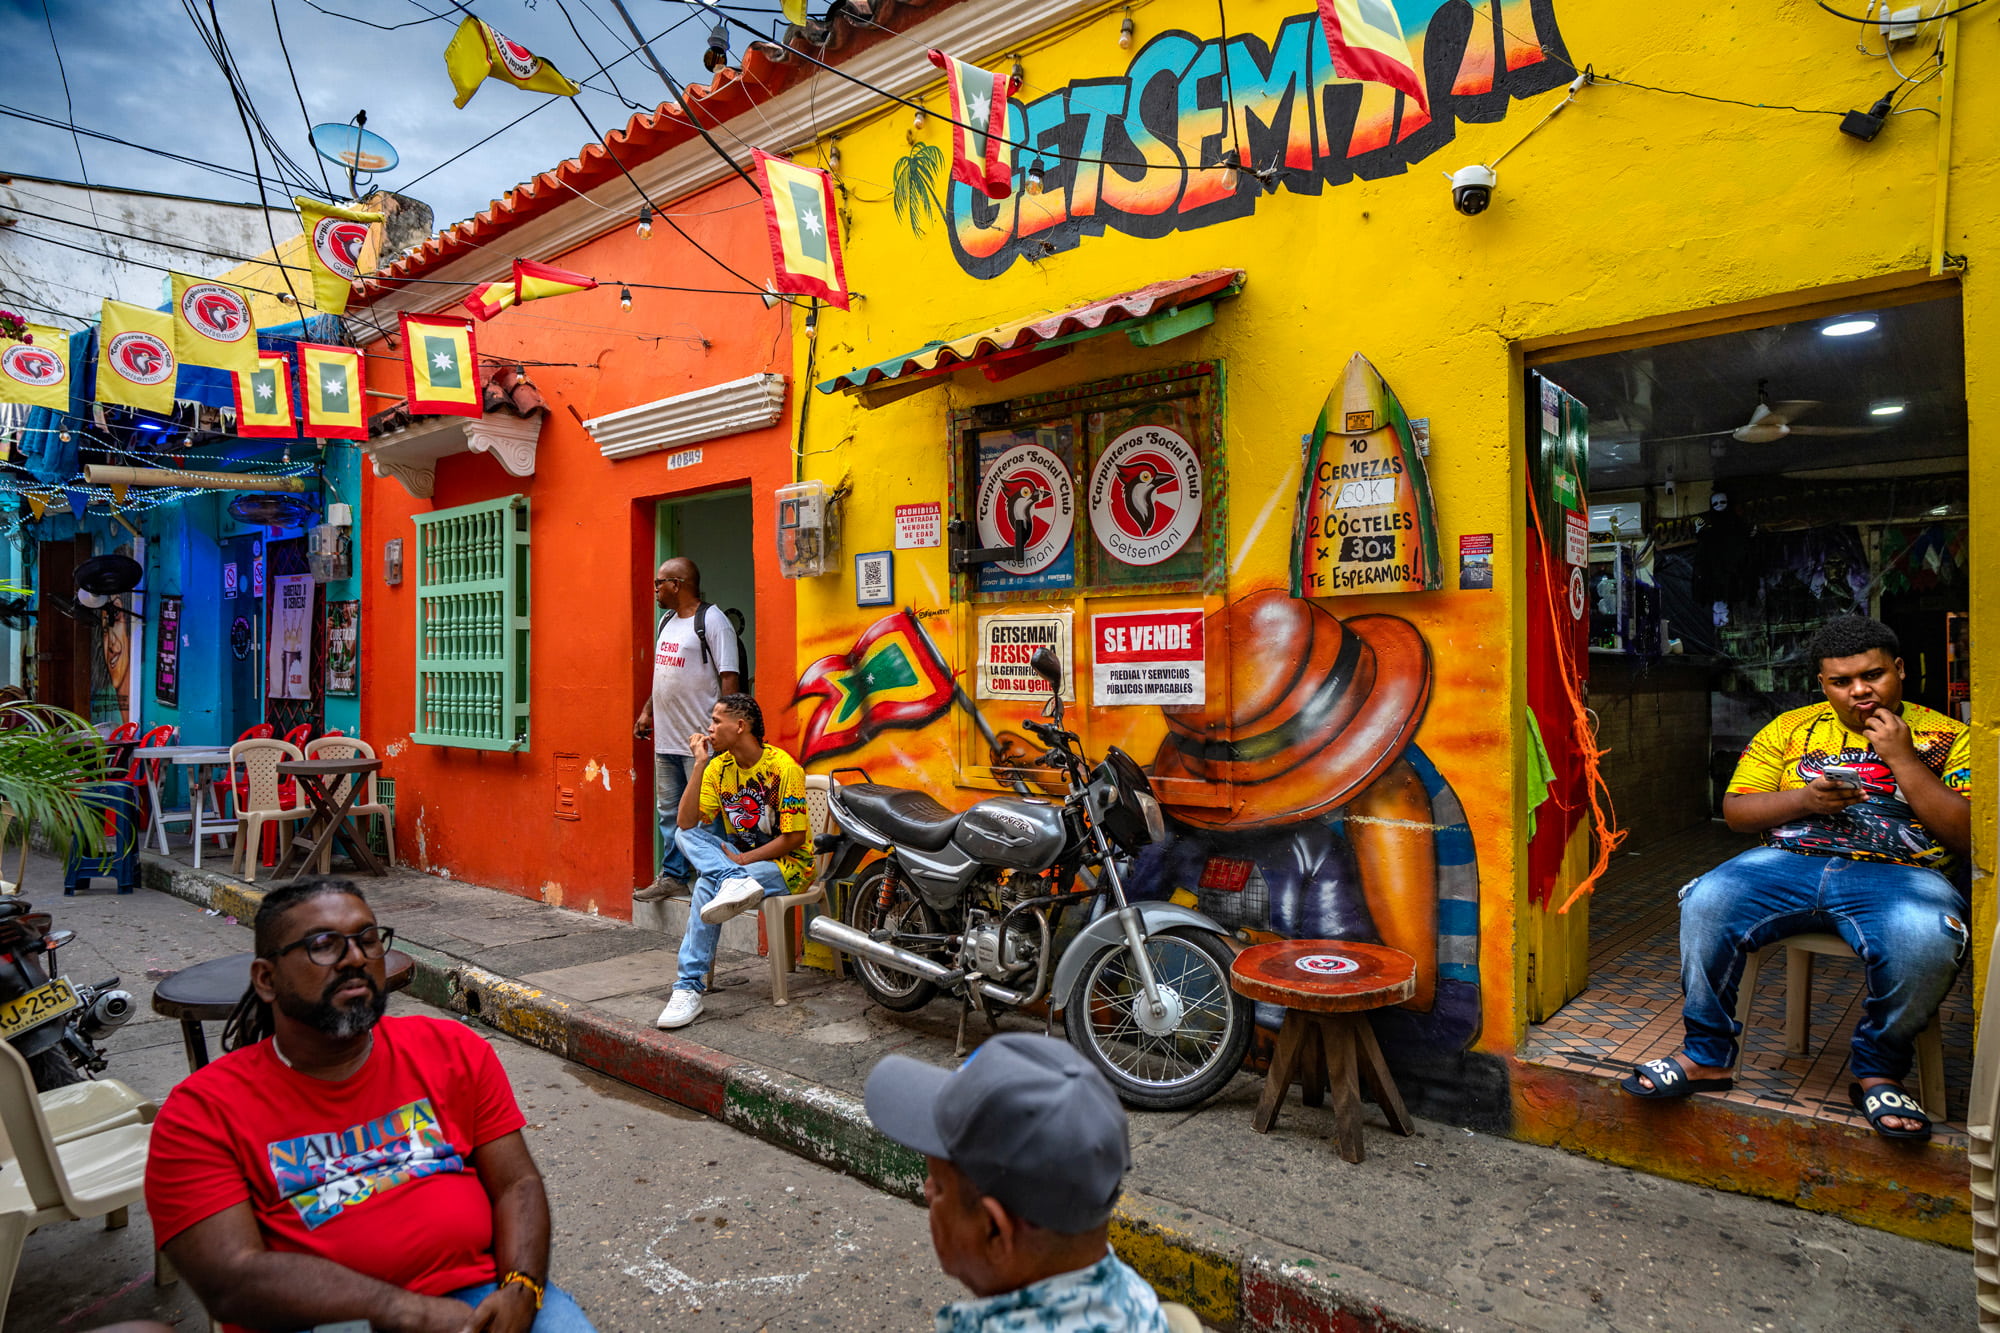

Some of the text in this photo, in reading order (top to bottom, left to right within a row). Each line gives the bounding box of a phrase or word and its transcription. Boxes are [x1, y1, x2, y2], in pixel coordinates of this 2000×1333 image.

[185, 287, 249, 323] Carpinteros Social Club
[196, 322, 240, 339] Getsemani
[110, 335, 144, 356] Carpinteros
[145, 335, 168, 352] Social
[120, 367, 161, 382] Getsemani
[1350, 439, 1368, 453] 10
[1091, 432, 1200, 511] Carpinteros Social Club
[1318, 456, 1403, 482] CERVEZAS
[980, 450, 1072, 521] Carpinteros Social Club
[897, 506, 939, 516] PROHIBIDA
[902, 523, 934, 531] MENORES
[1309, 512, 1412, 538] 2 CÓCTELES
[1109, 527, 1182, 559] Getsemani
[1351, 539, 1392, 558] 30K
[1307, 573, 1325, 588] TE
[992, 622, 1057, 643] GETSEMANÍ
[1104, 623, 1192, 653] SE VENDE
[660, 641, 679, 653] CENSO
[990, 644, 1047, 664] RESIST
[655, 654, 686, 668] ETSEMANI
[990, 665, 999, 675] LA
[1110, 668, 1190, 680] PREDIAL Y SERVICIOS
[992, 678, 1011, 690] con
[1013, 678, 1026, 691] su
[1106, 682, 1193, 695] PÚBLICOS IMPAGABLES
[25, 984, 71, 1016] 25D
[1642, 1059, 1679, 1085] OSS
[271, 1102, 435, 1169] NAUTICA
